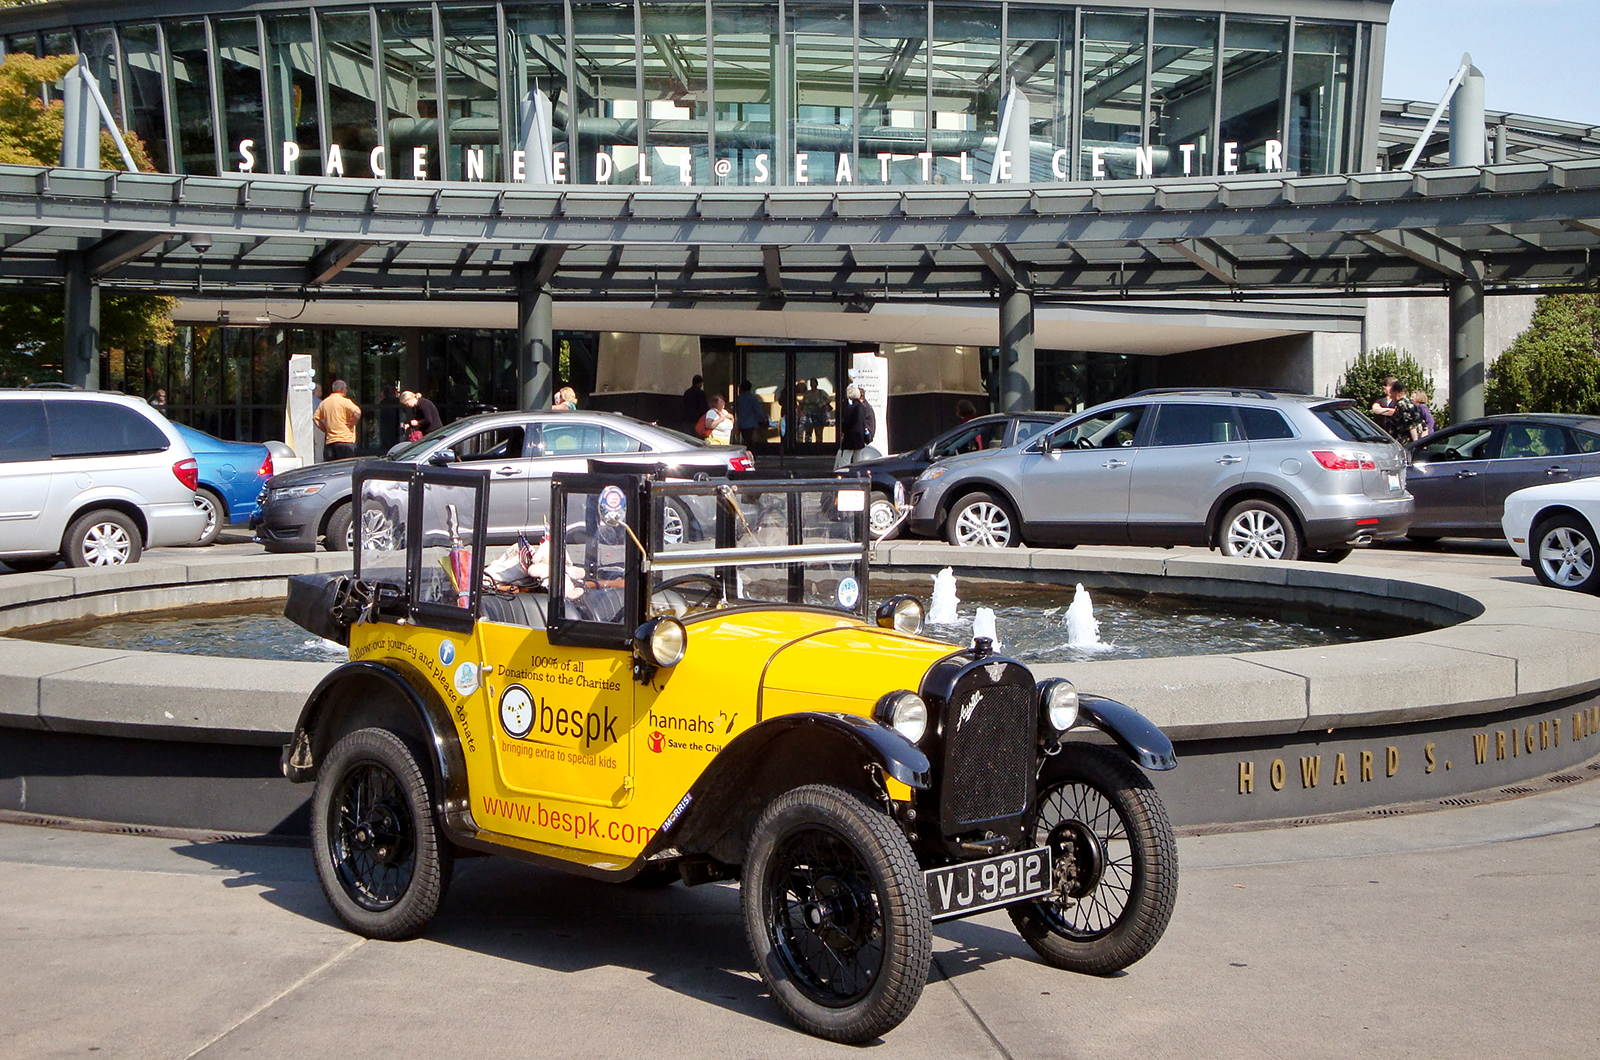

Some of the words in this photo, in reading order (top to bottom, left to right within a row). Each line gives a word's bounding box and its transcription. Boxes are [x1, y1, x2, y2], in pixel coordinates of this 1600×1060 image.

[238, 138, 429, 179] SPACE
[466, 148, 693, 183] NEEDLE
[714, 159, 732, 176] @
[754, 150, 1013, 184] SEATTLE
[1051, 140, 1284, 179] CENTER
[498, 664, 543, 681] Donations
[545, 672, 555, 683] to
[557, 673, 574, 685] the
[576, 675, 621, 691] Charities
[531, 655, 558, 669] 100%
[560, 660, 572, 673] of
[573, 662, 584, 673] all
[372, 639, 386, 650] our
[387, 637, 417, 659] journey
[418, 652, 434, 671] and
[432, 667, 457, 703] please
[456, 705, 476, 752] donate
[540, 697, 618, 748] bespk
[649, 709, 715, 734] hannahs
[502, 741, 533, 758] bringing
[535, 748, 555, 760] extra
[557, 750, 566, 761] to
[567, 751, 597, 767] special
[598, 755, 617, 769] kids
[668, 739, 687, 749] Save
[689, 742, 704, 751] the
[1238, 746, 1400, 794] HOWARD
[1424, 743, 1453, 774] S.
[1473, 718, 1563, 765] WRIGHT
[483, 796, 657, 845] www.bespk.com
[936, 869, 975, 911] VJ
[980, 854, 1042, 901] 9212
